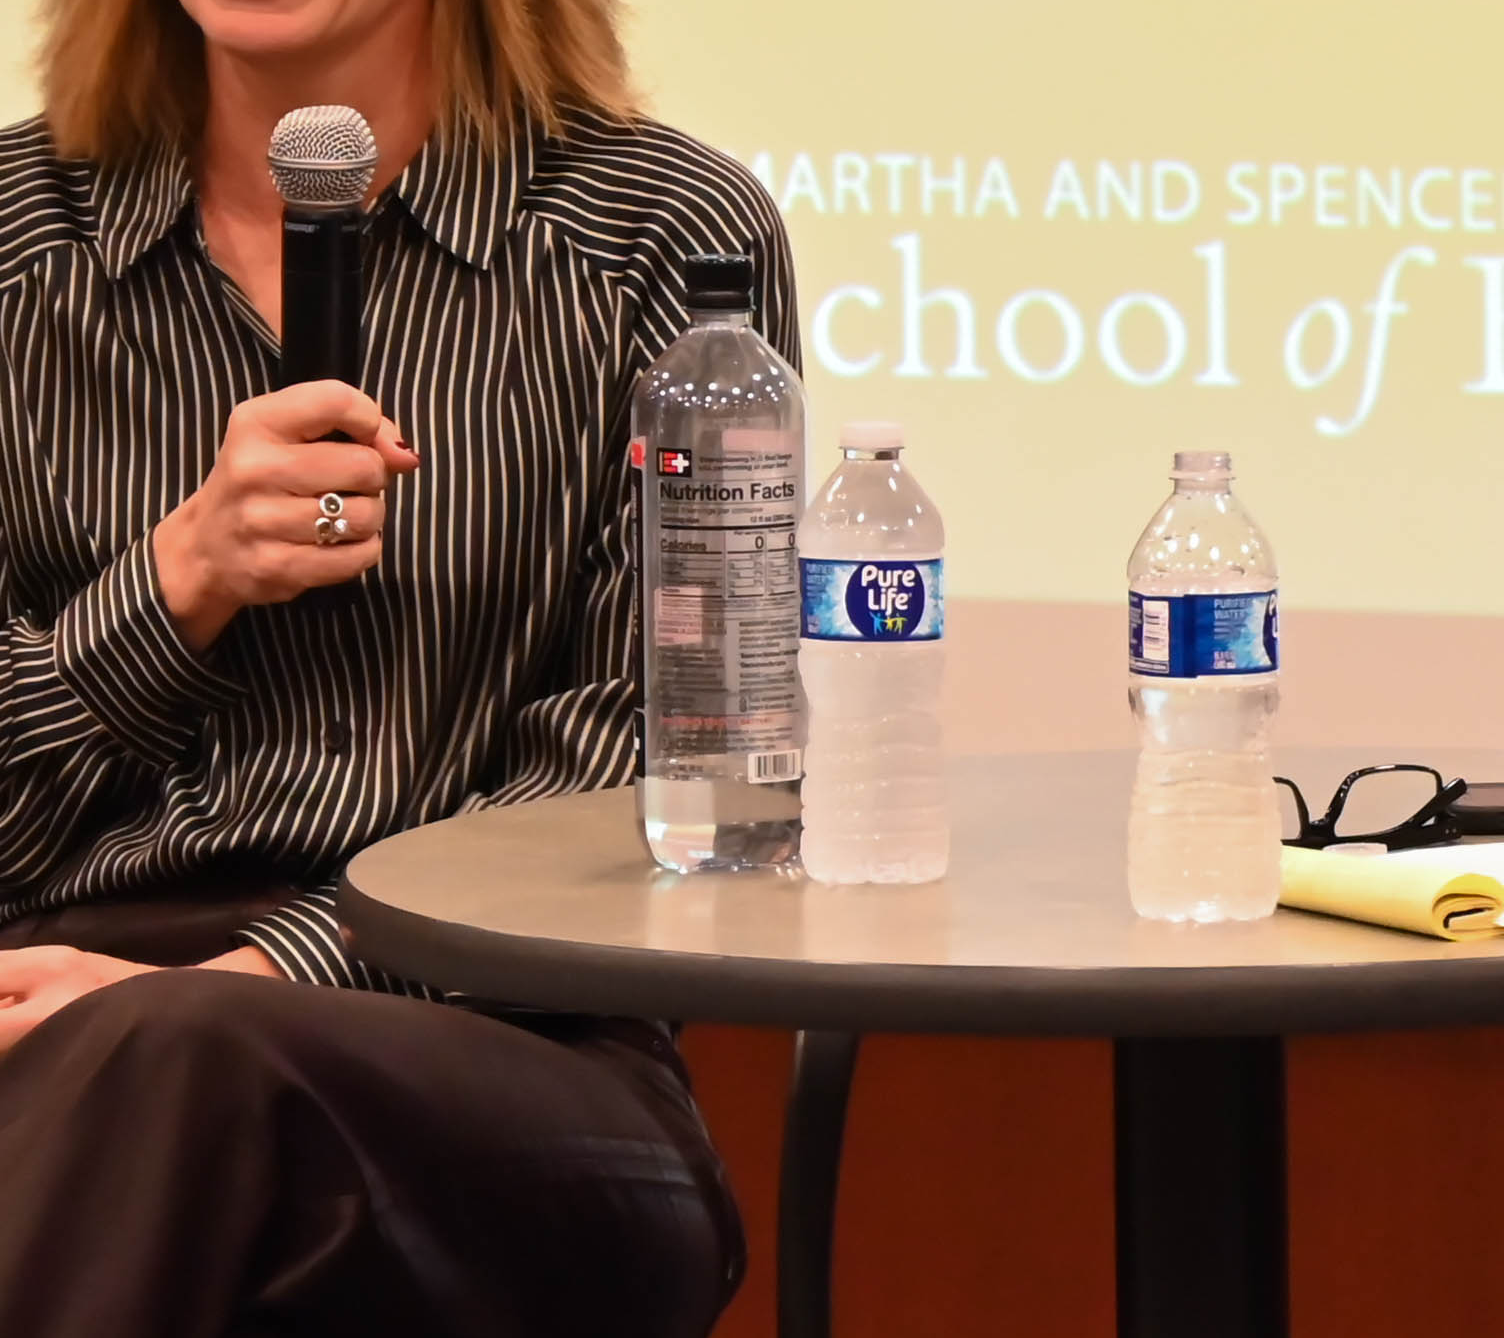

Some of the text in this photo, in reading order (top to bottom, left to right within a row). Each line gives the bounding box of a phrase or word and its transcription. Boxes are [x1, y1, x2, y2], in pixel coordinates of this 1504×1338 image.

[1043, 158, 1202, 223] AND
[809, 231, 1242, 387] chool
[1282, 244, 1438, 438] of
[660, 481, 795, 501] Nutrition Facts
[861, 564, 915, 587] Pure
[868, 588, 908, 616] Life
